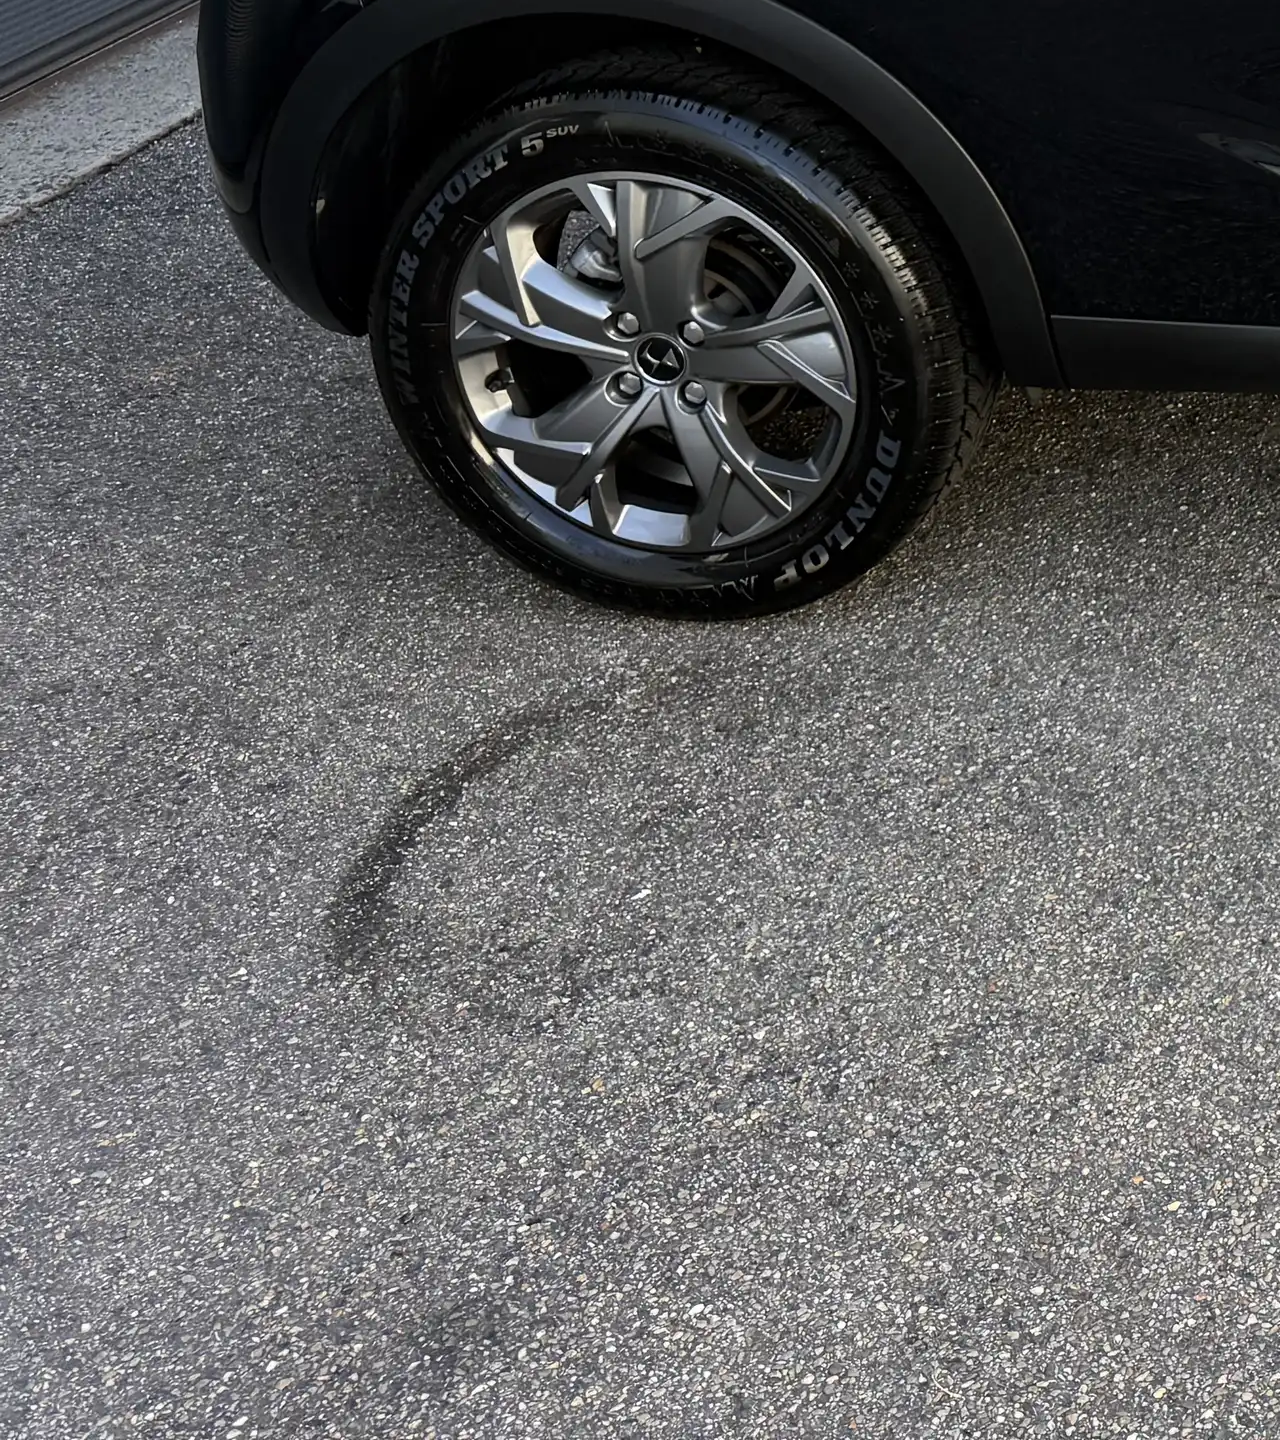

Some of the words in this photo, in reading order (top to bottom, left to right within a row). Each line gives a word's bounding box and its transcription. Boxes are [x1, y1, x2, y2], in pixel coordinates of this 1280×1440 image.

[388, 249, 420, 405] WINTER
[412, 143, 509, 248] SPORT
[520, 131, 544, 157] 5
[546, 123, 580, 138] SUV
[773, 429, 902, 592] DUNLOP
